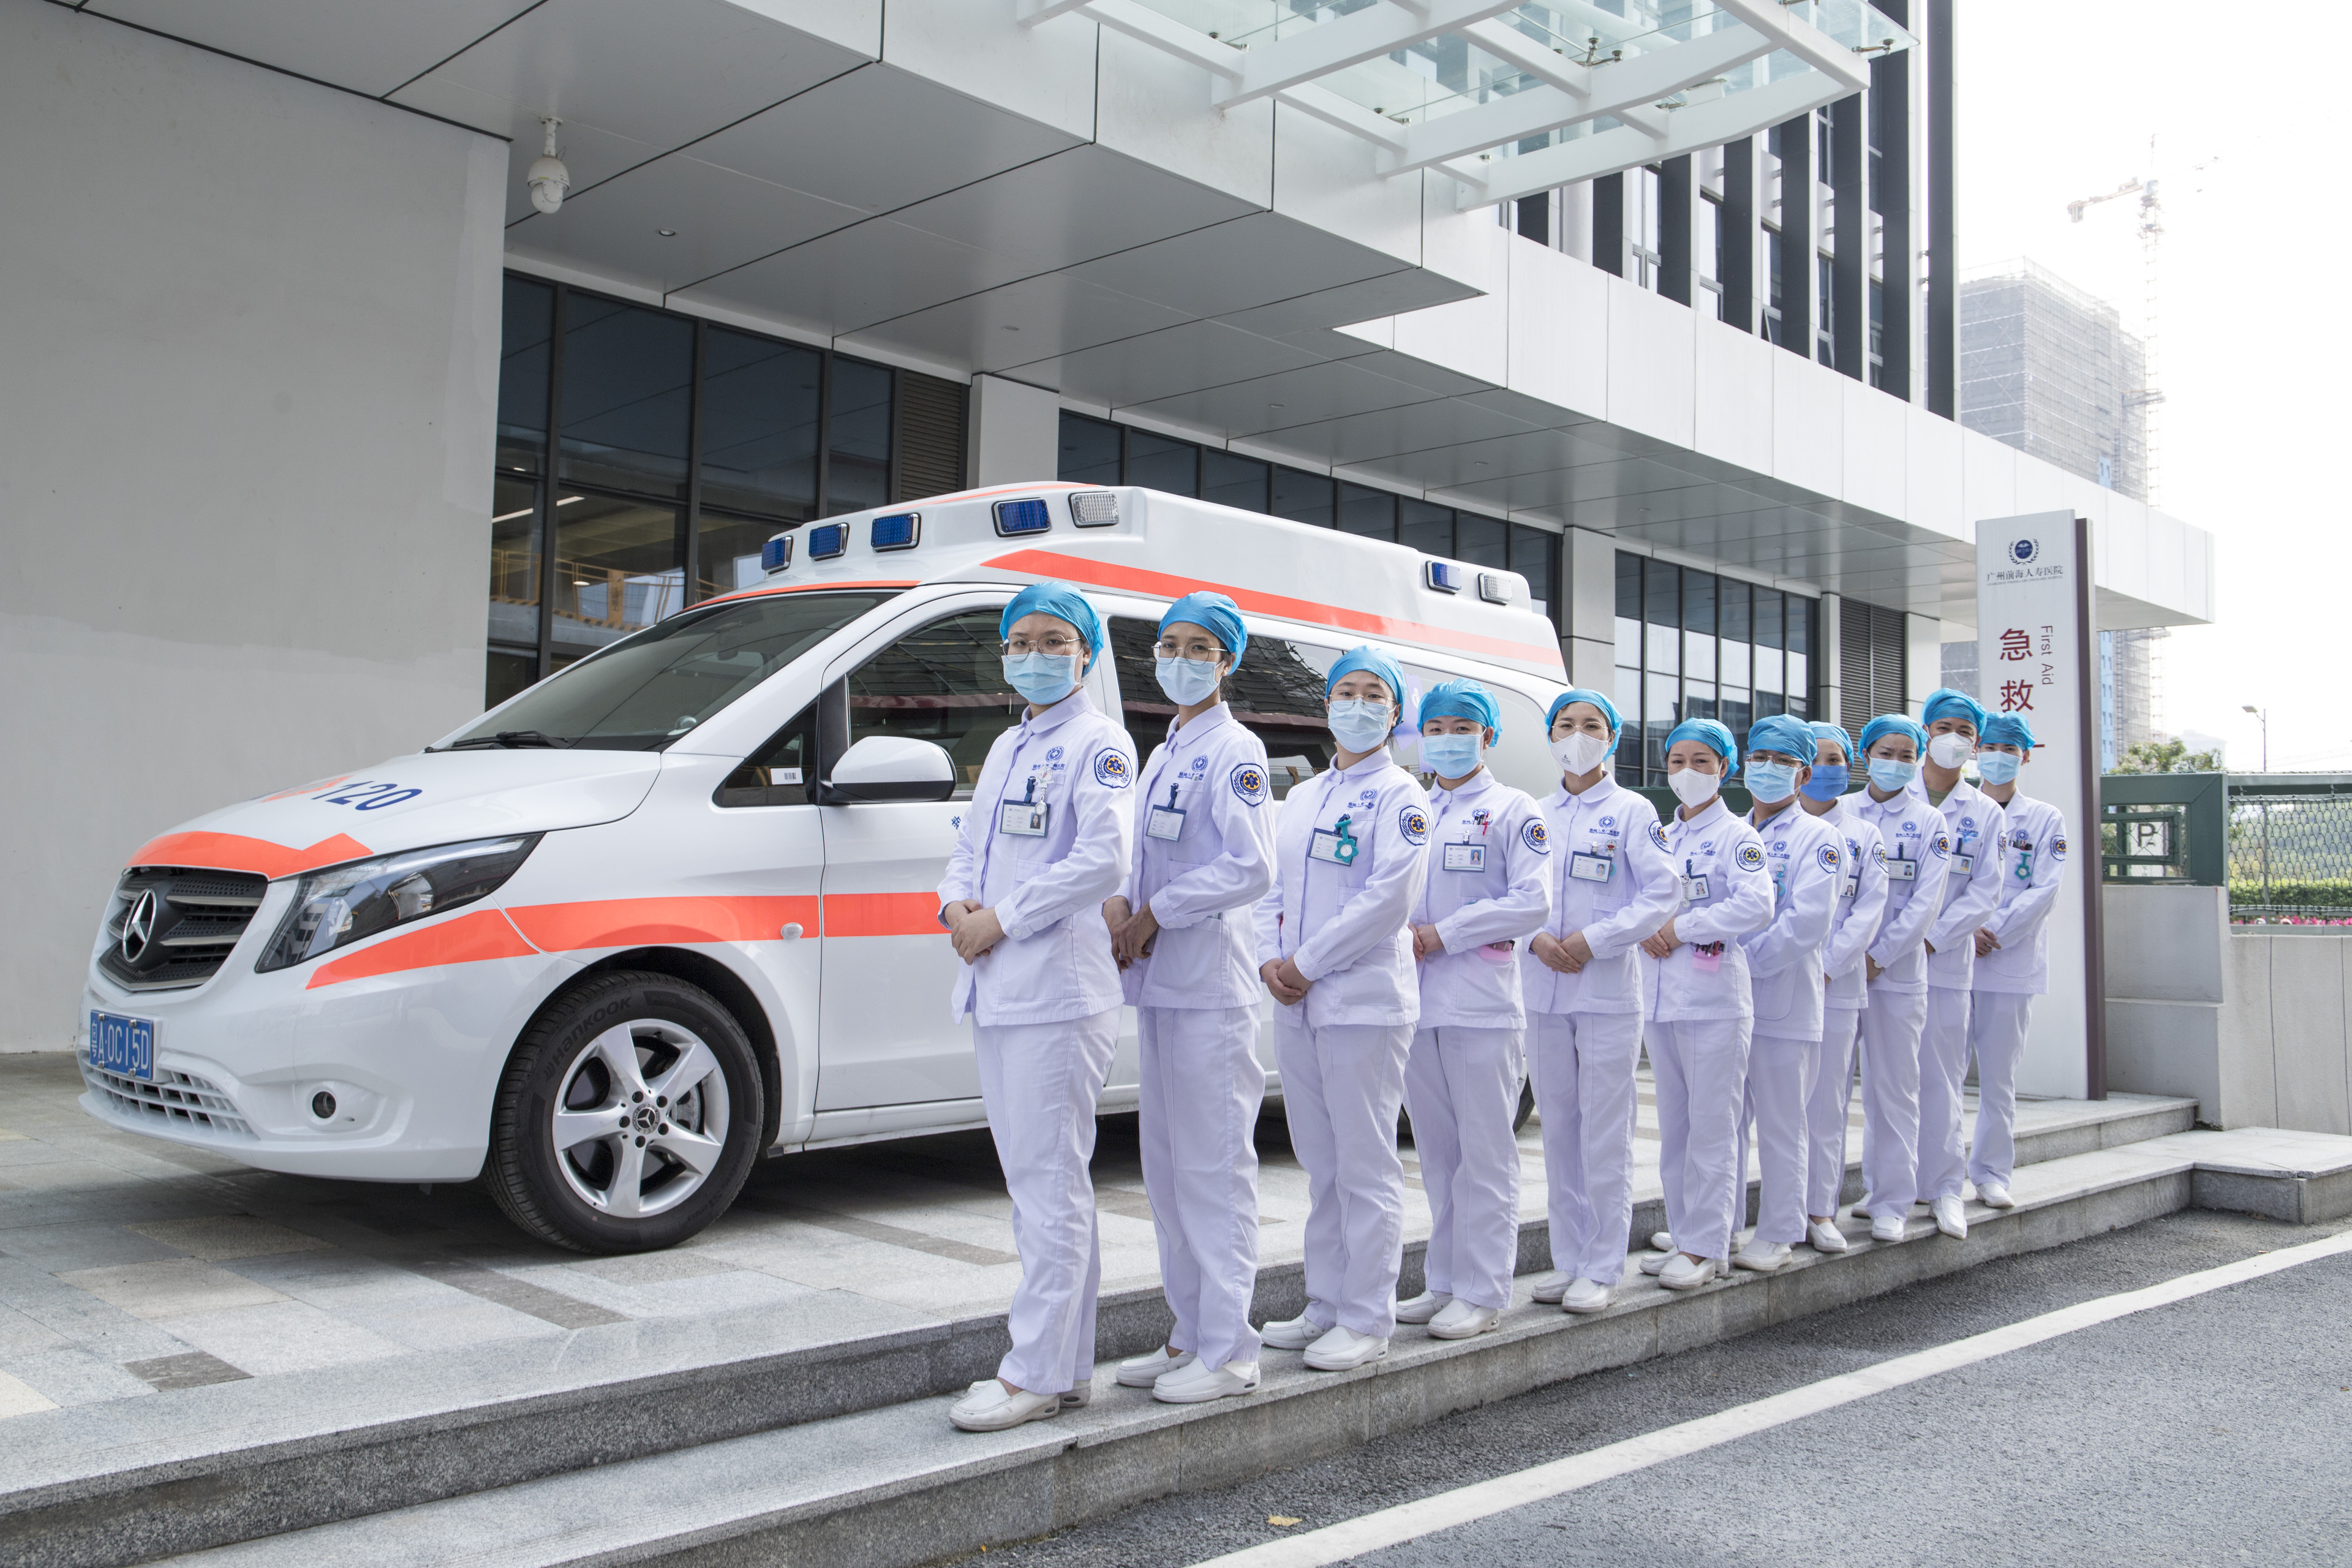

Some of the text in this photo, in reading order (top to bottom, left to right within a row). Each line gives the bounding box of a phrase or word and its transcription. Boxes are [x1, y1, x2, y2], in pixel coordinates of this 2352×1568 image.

[1987, 565, 2064, 581] 广州前海人寿医院
[1999, 628, 2034, 712] 急救
[2041, 625, 2054, 685] First Aid
[311, 781, 423, 811] 120
[2138, 823, 2156, 846] P
